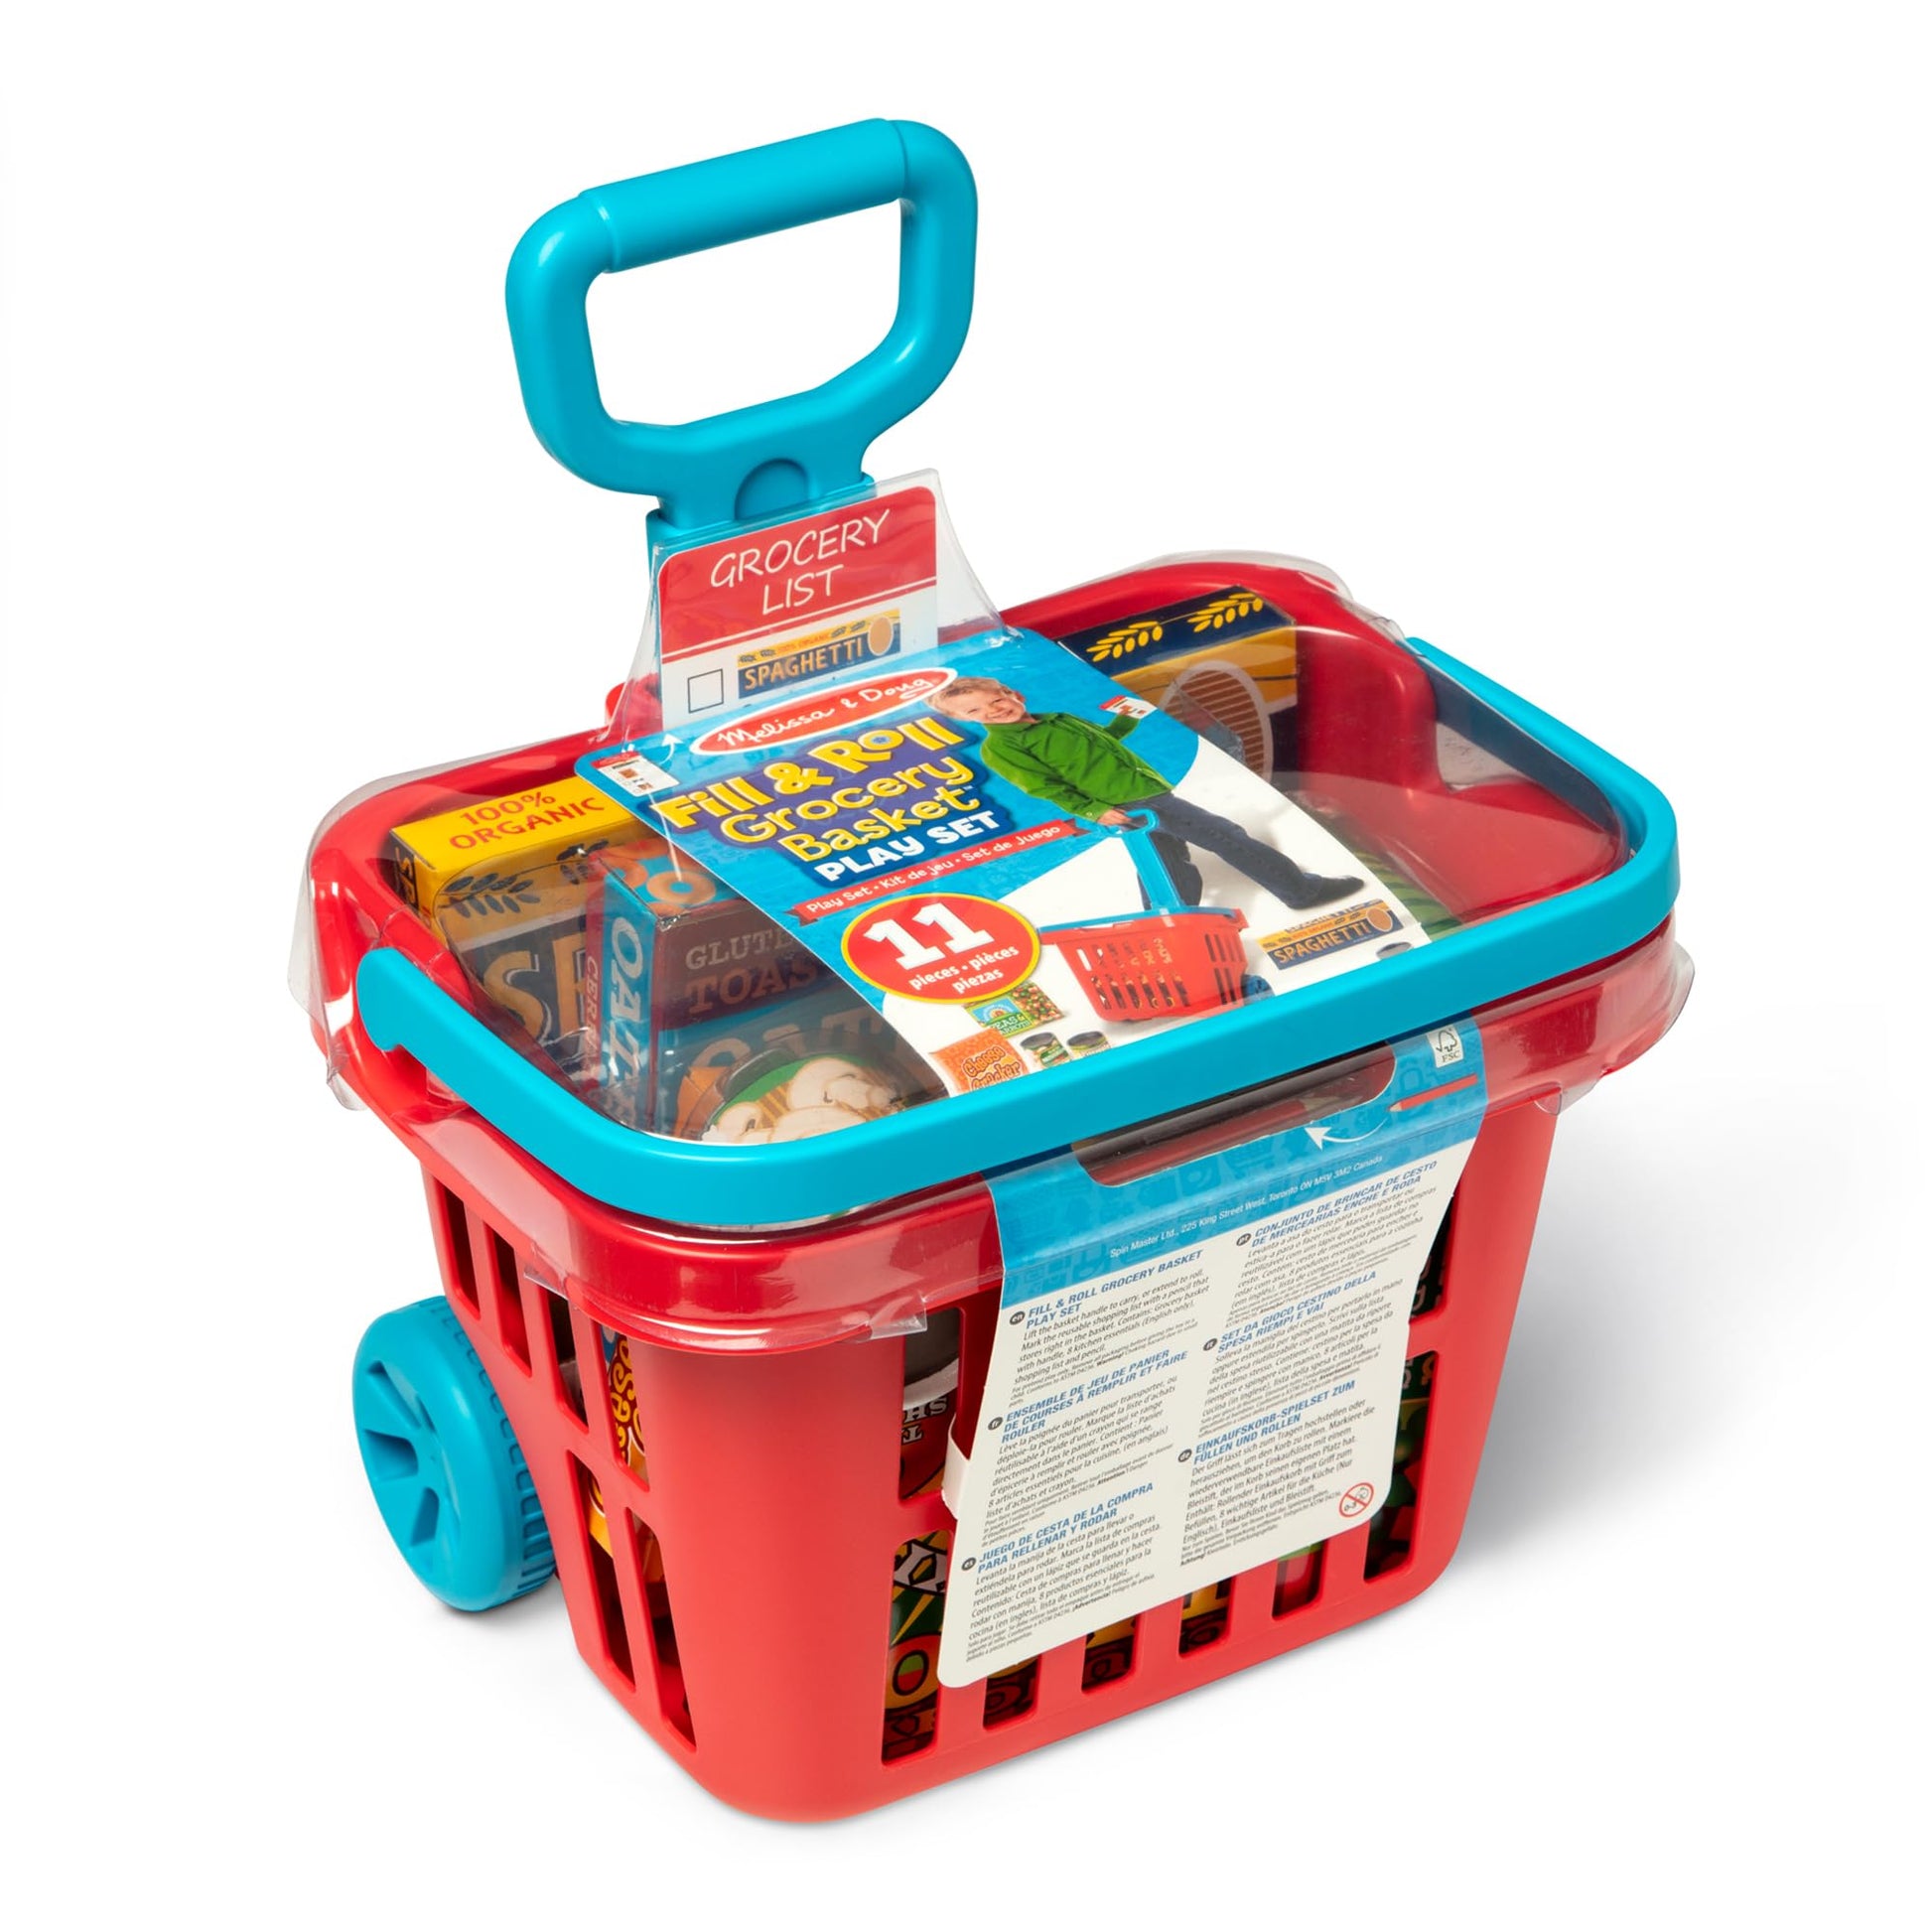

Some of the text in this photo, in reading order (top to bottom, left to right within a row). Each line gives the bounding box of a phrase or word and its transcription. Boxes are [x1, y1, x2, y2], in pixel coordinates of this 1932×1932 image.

[711, 508, 893, 589] GROCERY
[761, 564, 844, 616] LIST
[744, 638, 864, 691] SPAGHETTI
[718, 678, 933, 746] Melissa & Doug
[650, 717, 965, 829] Fill & Roll
[720, 756, 974, 843] Grocery
[449, 796, 606, 851] ORGANIC
[460, 790, 558, 828] 100%
[806, 826, 1060, 912] Play Set Kit de jeu Set de Juego
[813, 810, 1000, 882] PLAY SET
[864, 902, 995, 970] 11
[909, 945, 1020, 990] pieces pièces
[1274, 921, 1369, 964] SPAGHETTI
[952, 967, 1004, 994] piezas
[963, 1046, 1006, 1077] Cheese
[1110, 1245, 1129, 1258] Spin
[1130, 1235, 1159, 1250] Master
[1198, 1215, 1217, 1226] King
[1218, 1204, 1244, 1219] Street
[1352, 1156, 1382, 1171] Canada
[1251, 1235, 1267, 1248] DE
[1269, 1206, 1341, 1241] MERCEARIAS
[1342, 1191, 1380, 1211] ENCHE
[1381, 1187, 1389, 1196] E
[1391, 1174, 1421, 1192] RODA
[1254, 1160, 1438, 1237] CONJUNTO DE BRINCAR DE CESTO
[1026, 1302, 1082, 1329] PLAY SET
[1028, 1303, 1052, 1318] FILL
[1055, 1298, 1064, 1309] &
[1067, 1287, 1097, 1305] ROLL
[1100, 1266, 1155, 1293] GROCERY
[1158, 1249, 1202, 1273] BASKET
[1220, 1327, 1241, 1342] SET
[1243, 1320, 1258, 1333] DA
[1261, 1306, 1295, 1325] GIOCO
[1297, 1285, 1341, 1311] CESTINO
[1343, 1271, 1376, 1291] DELLA
[1217, 1302, 1324, 1353] SPESA RIEMPI E VAI
[1003, 1350, 1187, 1433] DE COURSES À REMPLIR ET FAIRE
[1006, 1391, 1066, 1422] ENSEMBLE
[1069, 1383, 1085, 1397] DE
[1086, 1374, 1109, 1390] JEU
[1111, 1366, 1126, 1380] DE
[1128, 1349, 1170, 1372] PANIER
[1195, 1390, 1329, 1453] EINKAUFSKORB-SPIELSET
[1331, 1379, 1355, 1397] ZUM
[1001, 1419, 1045, 1444] ROULER
[1193, 1441, 1233, 1465] FÜLLEN
[1235, 1431, 1258, 1448] UND
[1260, 1412, 1301, 1437] ROLLEN
[977, 1554, 1008, 1574] PARA
[1011, 1529, 1066, 1560] RELLENAR
[1070, 1524, 1077, 1534] Y
[1079, 1507, 1118, 1531] RODAR
[979, 1482, 1153, 1563] JUEGO DE CESTA DE LA COMPRA
